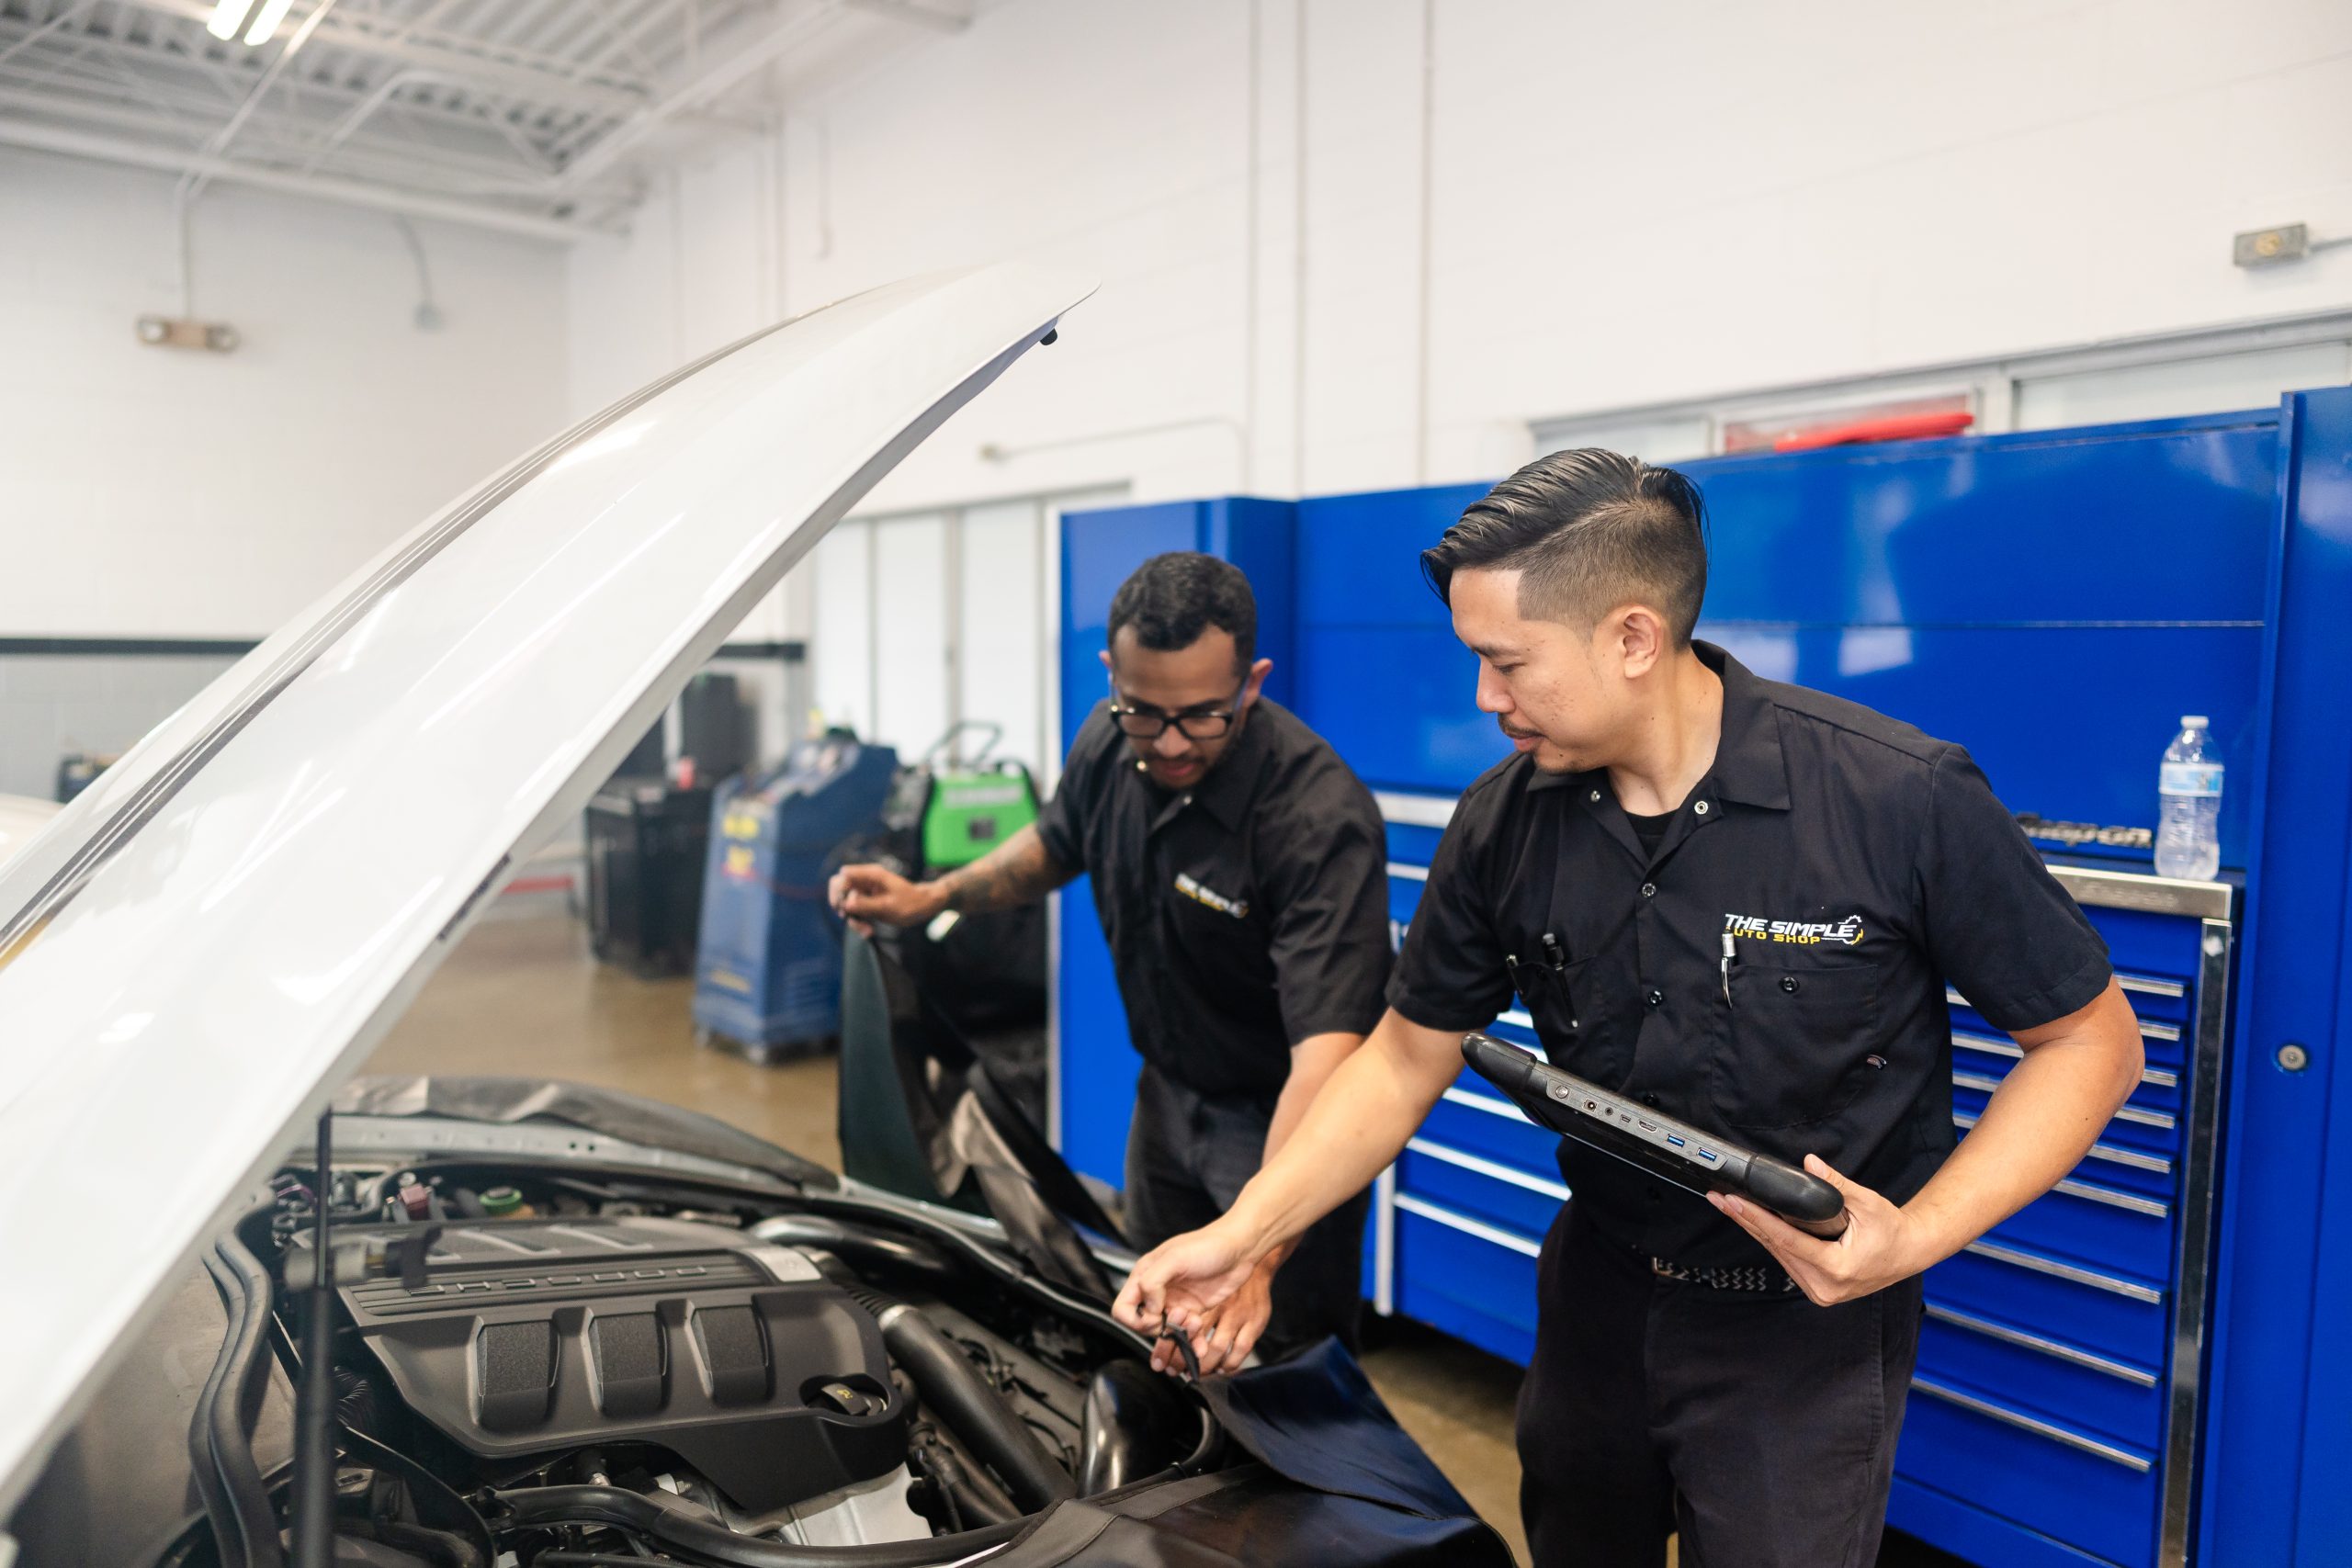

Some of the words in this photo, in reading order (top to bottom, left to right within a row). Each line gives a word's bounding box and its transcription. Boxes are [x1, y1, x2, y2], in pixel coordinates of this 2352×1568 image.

[1723, 926, 1767, 940] UTO
[1773, 933, 1820, 944] SHOP
[1724, 914, 1768, 931] THE
[1769, 921, 1857, 937] SIMPLE
